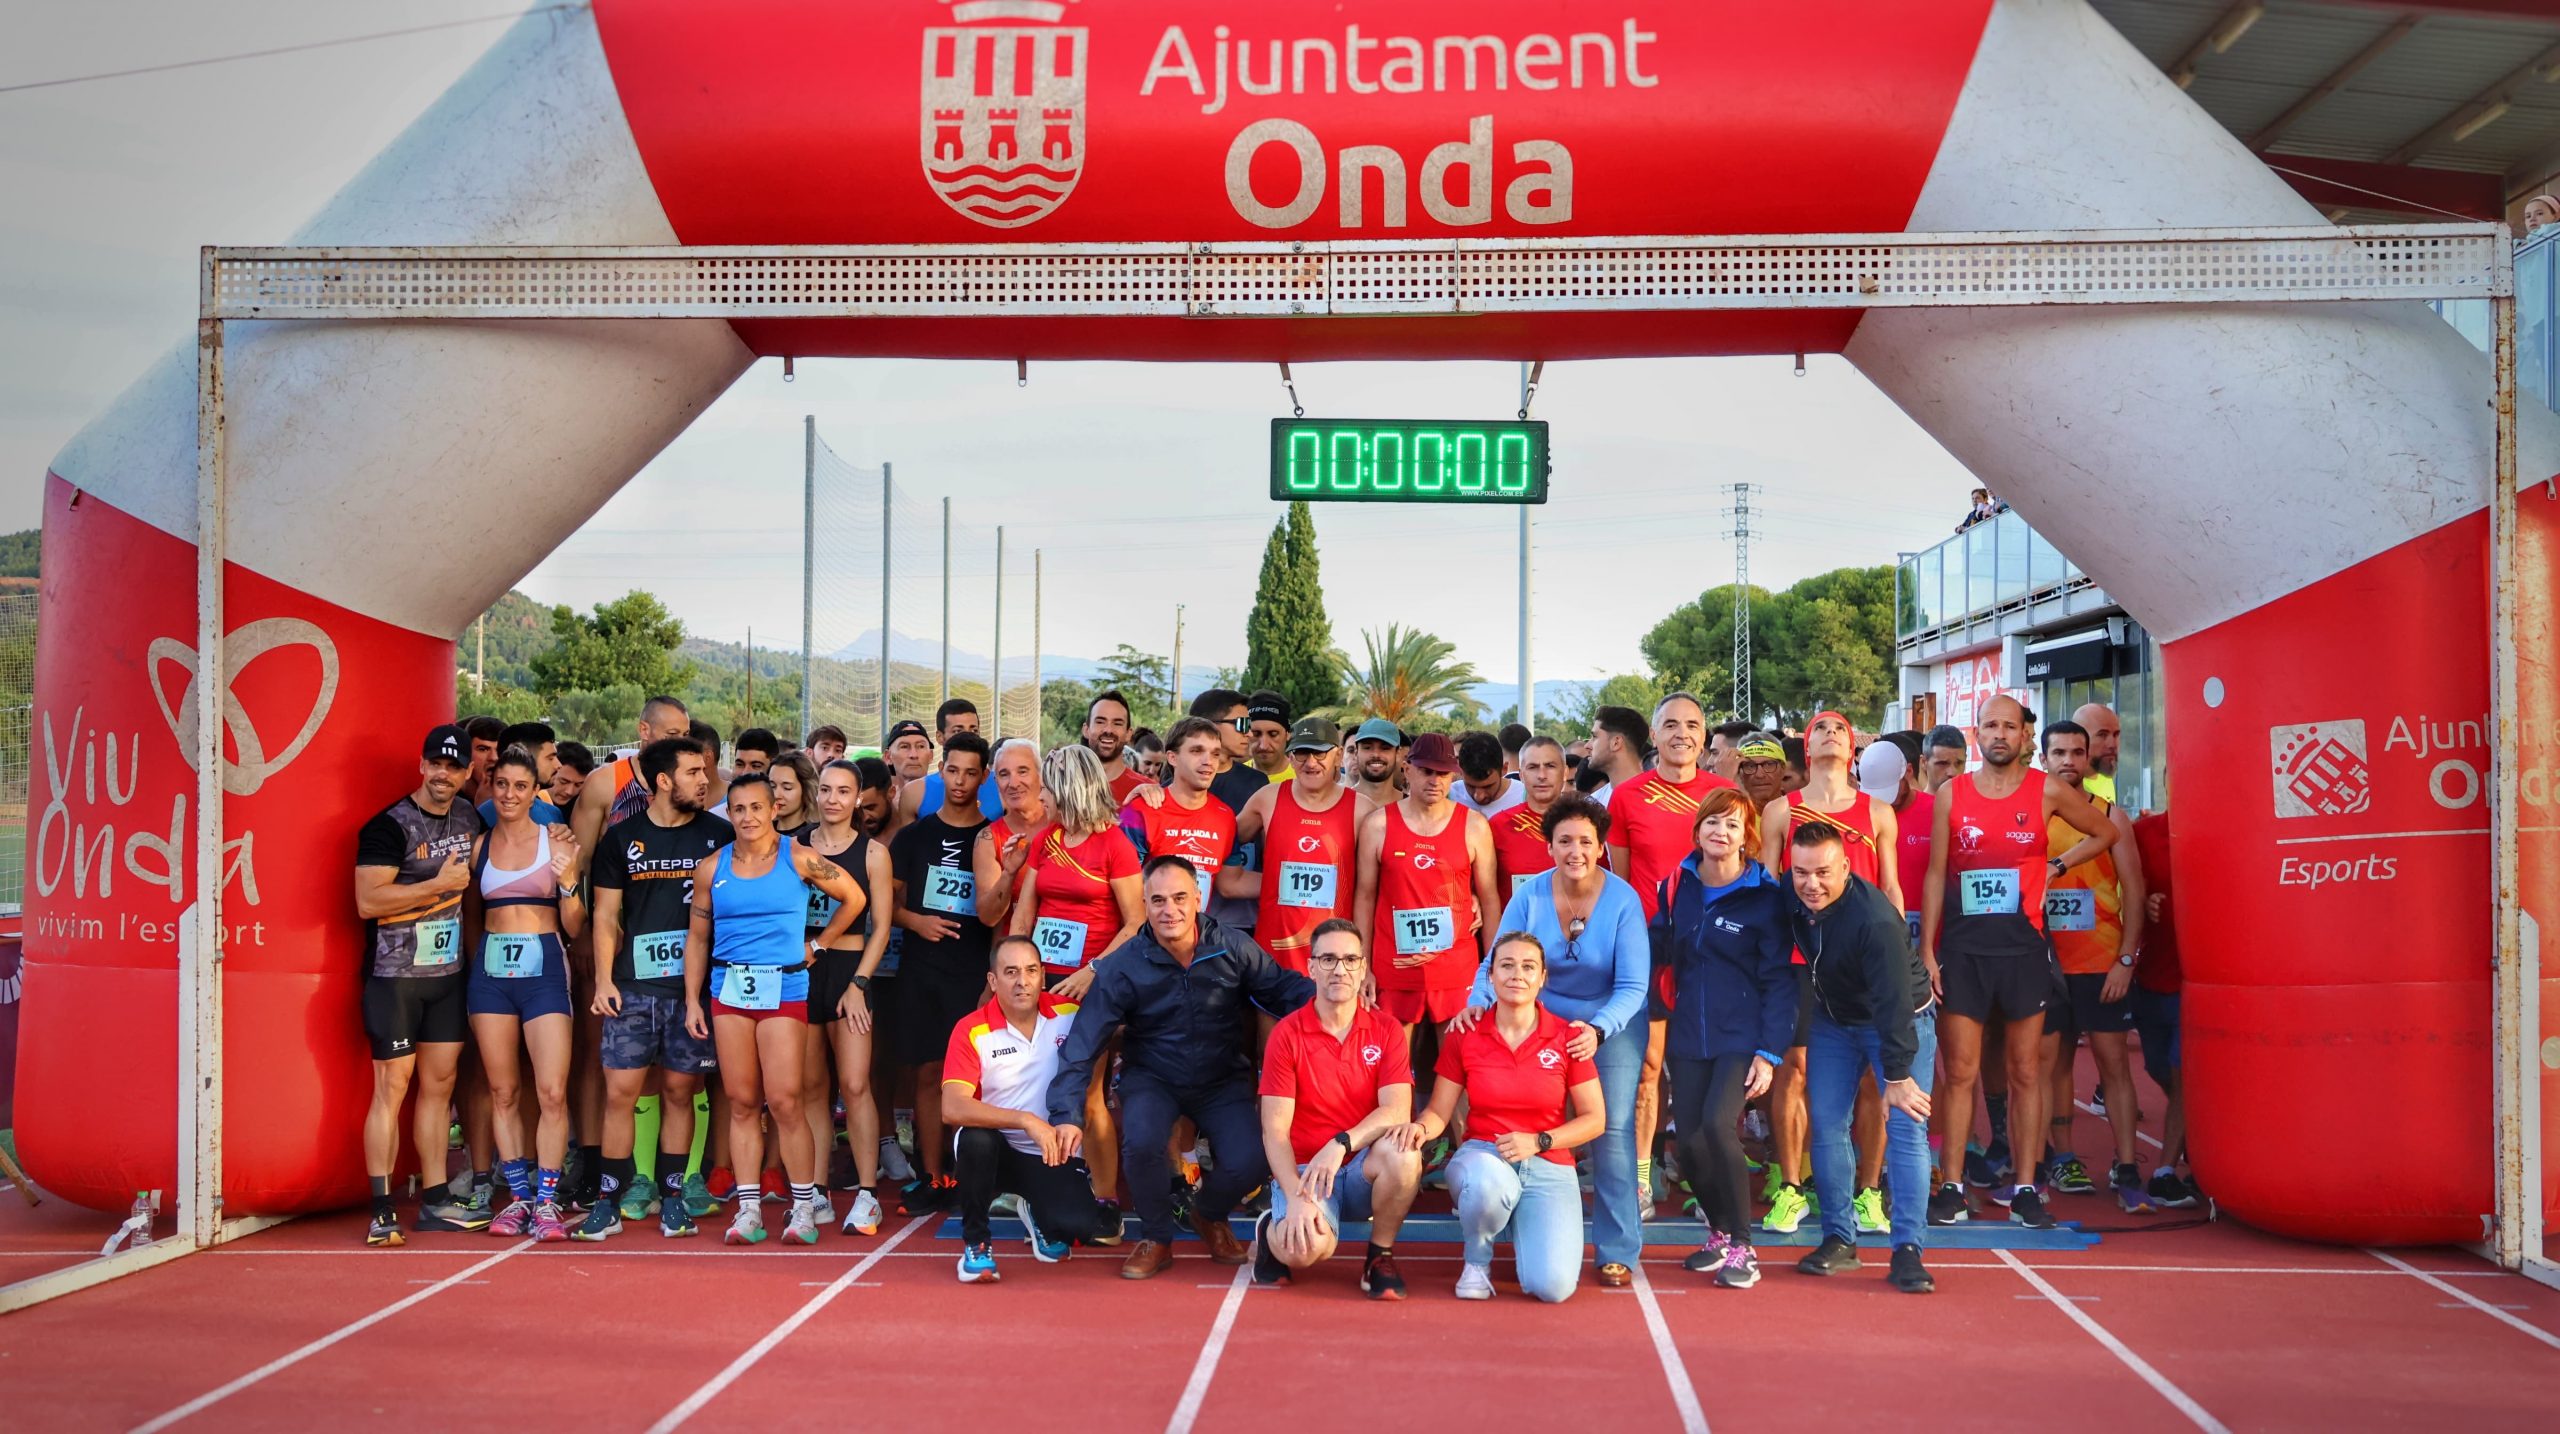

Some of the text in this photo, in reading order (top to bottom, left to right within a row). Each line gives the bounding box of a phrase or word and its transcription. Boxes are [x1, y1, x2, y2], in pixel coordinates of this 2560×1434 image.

[1140, 17, 1659, 115] Ajuntament
[1224, 114, 1575, 230] Onda
[1290, 431, 1528, 491] 00:00:00
[43, 705, 139, 806] Viu
[35, 793, 261, 906] Onda
[1290, 872, 1324, 892] 119
[2278, 853, 2398, 890] Esports
[936, 877, 972, 900] 228
[1971, 880, 2007, 899] 154
[2048, 898, 2082, 916] 232
[38, 911, 103, 940] vivim
[1406, 918, 1440, 938] 115
[434, 930, 452, 949] 67
[1041, 928, 1072, 950] 162
[502, 944, 524, 962] 17
[645, 941, 684, 963] 166
[743, 976, 756, 995] 3
